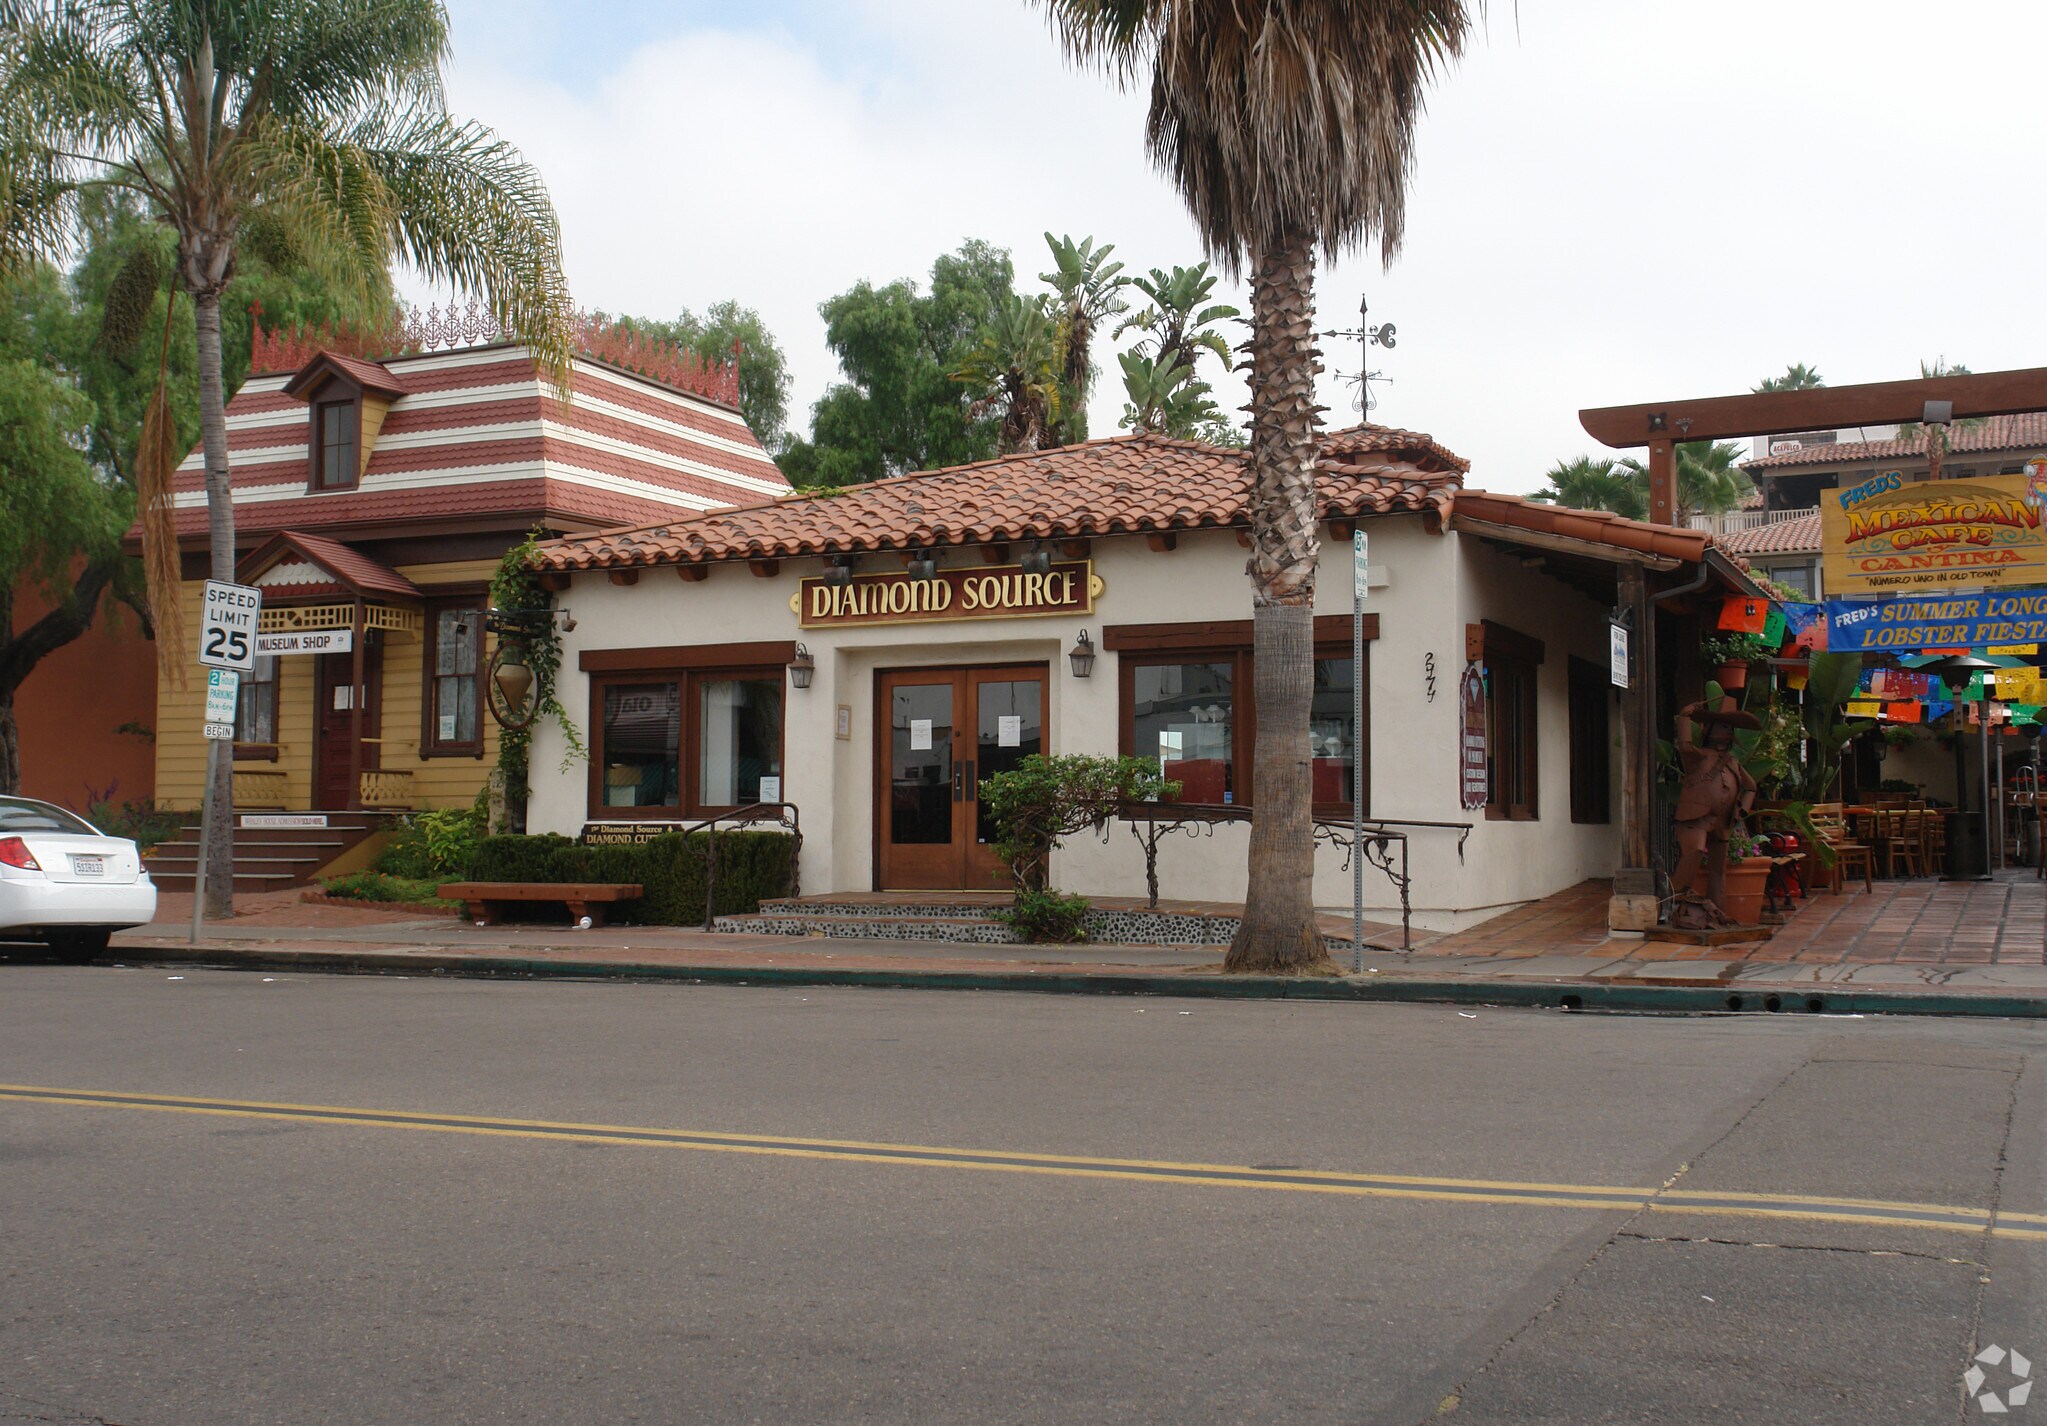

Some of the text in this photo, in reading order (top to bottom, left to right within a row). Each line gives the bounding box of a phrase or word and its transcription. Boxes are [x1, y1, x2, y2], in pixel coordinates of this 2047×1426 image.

[1839, 470, 1902, 511] FRED'S
[1844, 499, 2041, 544] MEXICAN
[1891, 525, 1993, 550] CAFE
[1860, 549, 2027, 572] CANTINA
[1913, 575, 1934, 583] UNO
[1937, 573, 1947, 582] IN
[1950, 571, 1968, 580] OLD
[208, 589, 256, 609] SPEED
[811, 571, 1078, 618] DIAMOND SOURCE
[210, 608, 250, 626] LIMIT
[1835, 595, 2047, 628] FRED'S SUMMER LONG
[205, 627, 248, 661] 25
[257, 637, 299, 651] MUSEUM
[302, 635, 331, 649] SHOP
[1861, 624, 1969, 647] LOBSTER
[210, 672, 236, 686] 2 HOUR
[209, 688, 234, 701] PARKING
[206, 726, 231, 737] BEGIN
[586, 834, 632, 844] DIAMOND
[600, 825, 634, 833] Diamond
[636, 825, 663, 833] Source
